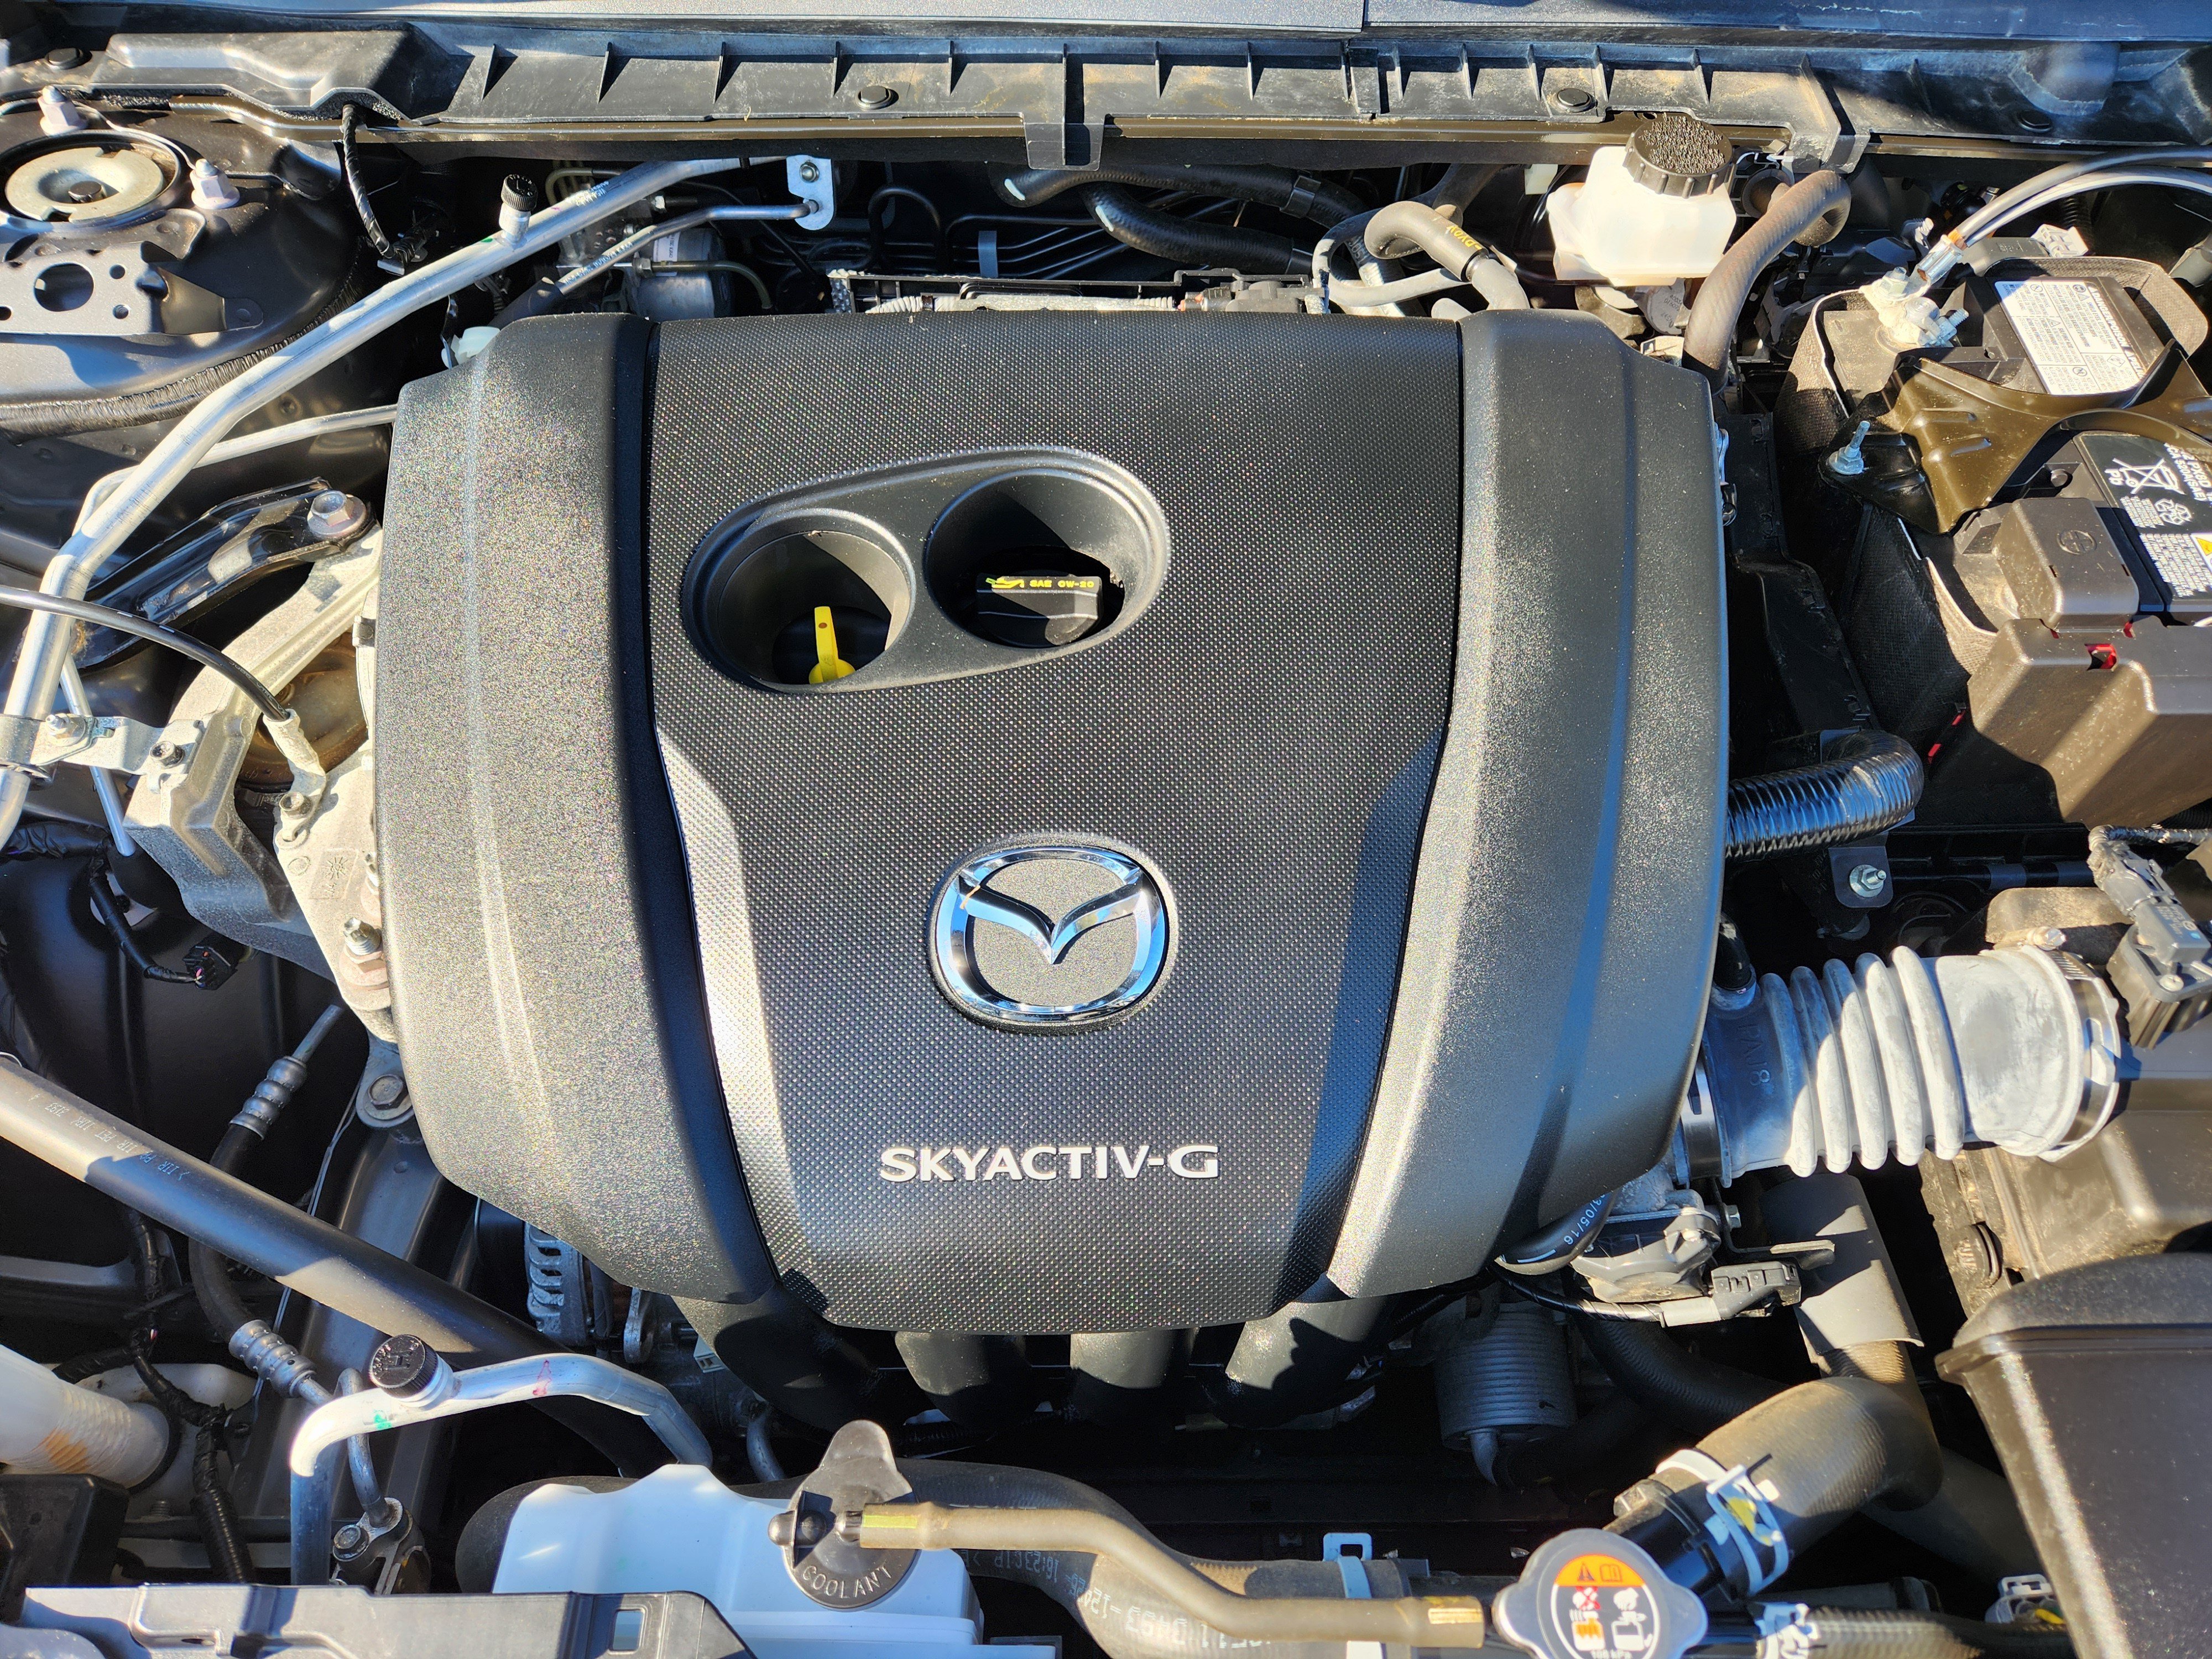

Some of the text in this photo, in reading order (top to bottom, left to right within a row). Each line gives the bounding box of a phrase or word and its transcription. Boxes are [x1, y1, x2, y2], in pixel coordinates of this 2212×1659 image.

[2090, 293, 2130, 347] DANGER/POISON
[2098, 322, 2111, 338] EXPLOSIVE
[2107, 339, 2117, 349] GASES
[2105, 469, 2124, 485] Pb
[2176, 460, 2207, 501] 520A(SAE)
[1029, 579, 1095, 588] SAE 0W-20
[879, 1144, 1219, 1182] SKYACTIV-G
[801, 1565, 895, 1600] COOLANT
